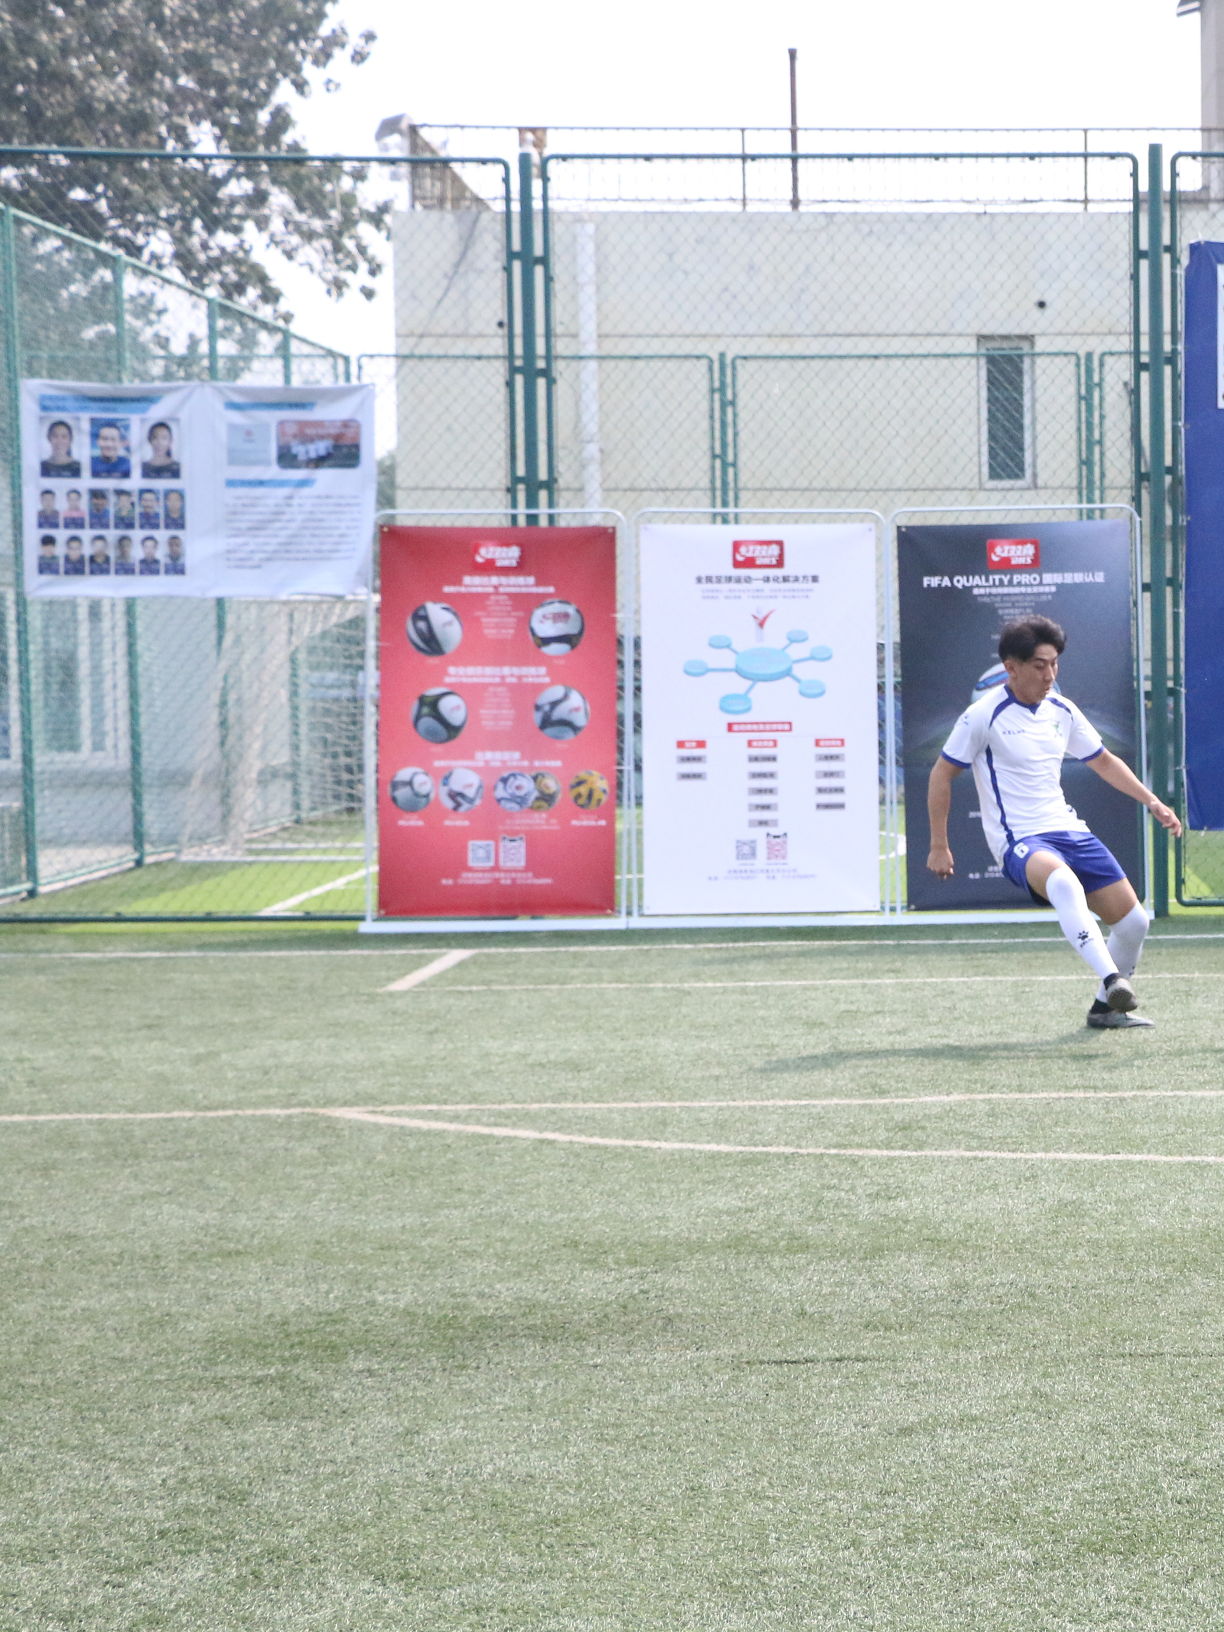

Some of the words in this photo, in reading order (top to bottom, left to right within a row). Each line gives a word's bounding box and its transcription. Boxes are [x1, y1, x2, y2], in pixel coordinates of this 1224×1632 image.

[923, 576, 951, 588] FIFA
[953, 574, 1010, 588] QUALITY
[1013, 573, 1040, 585] PRO
